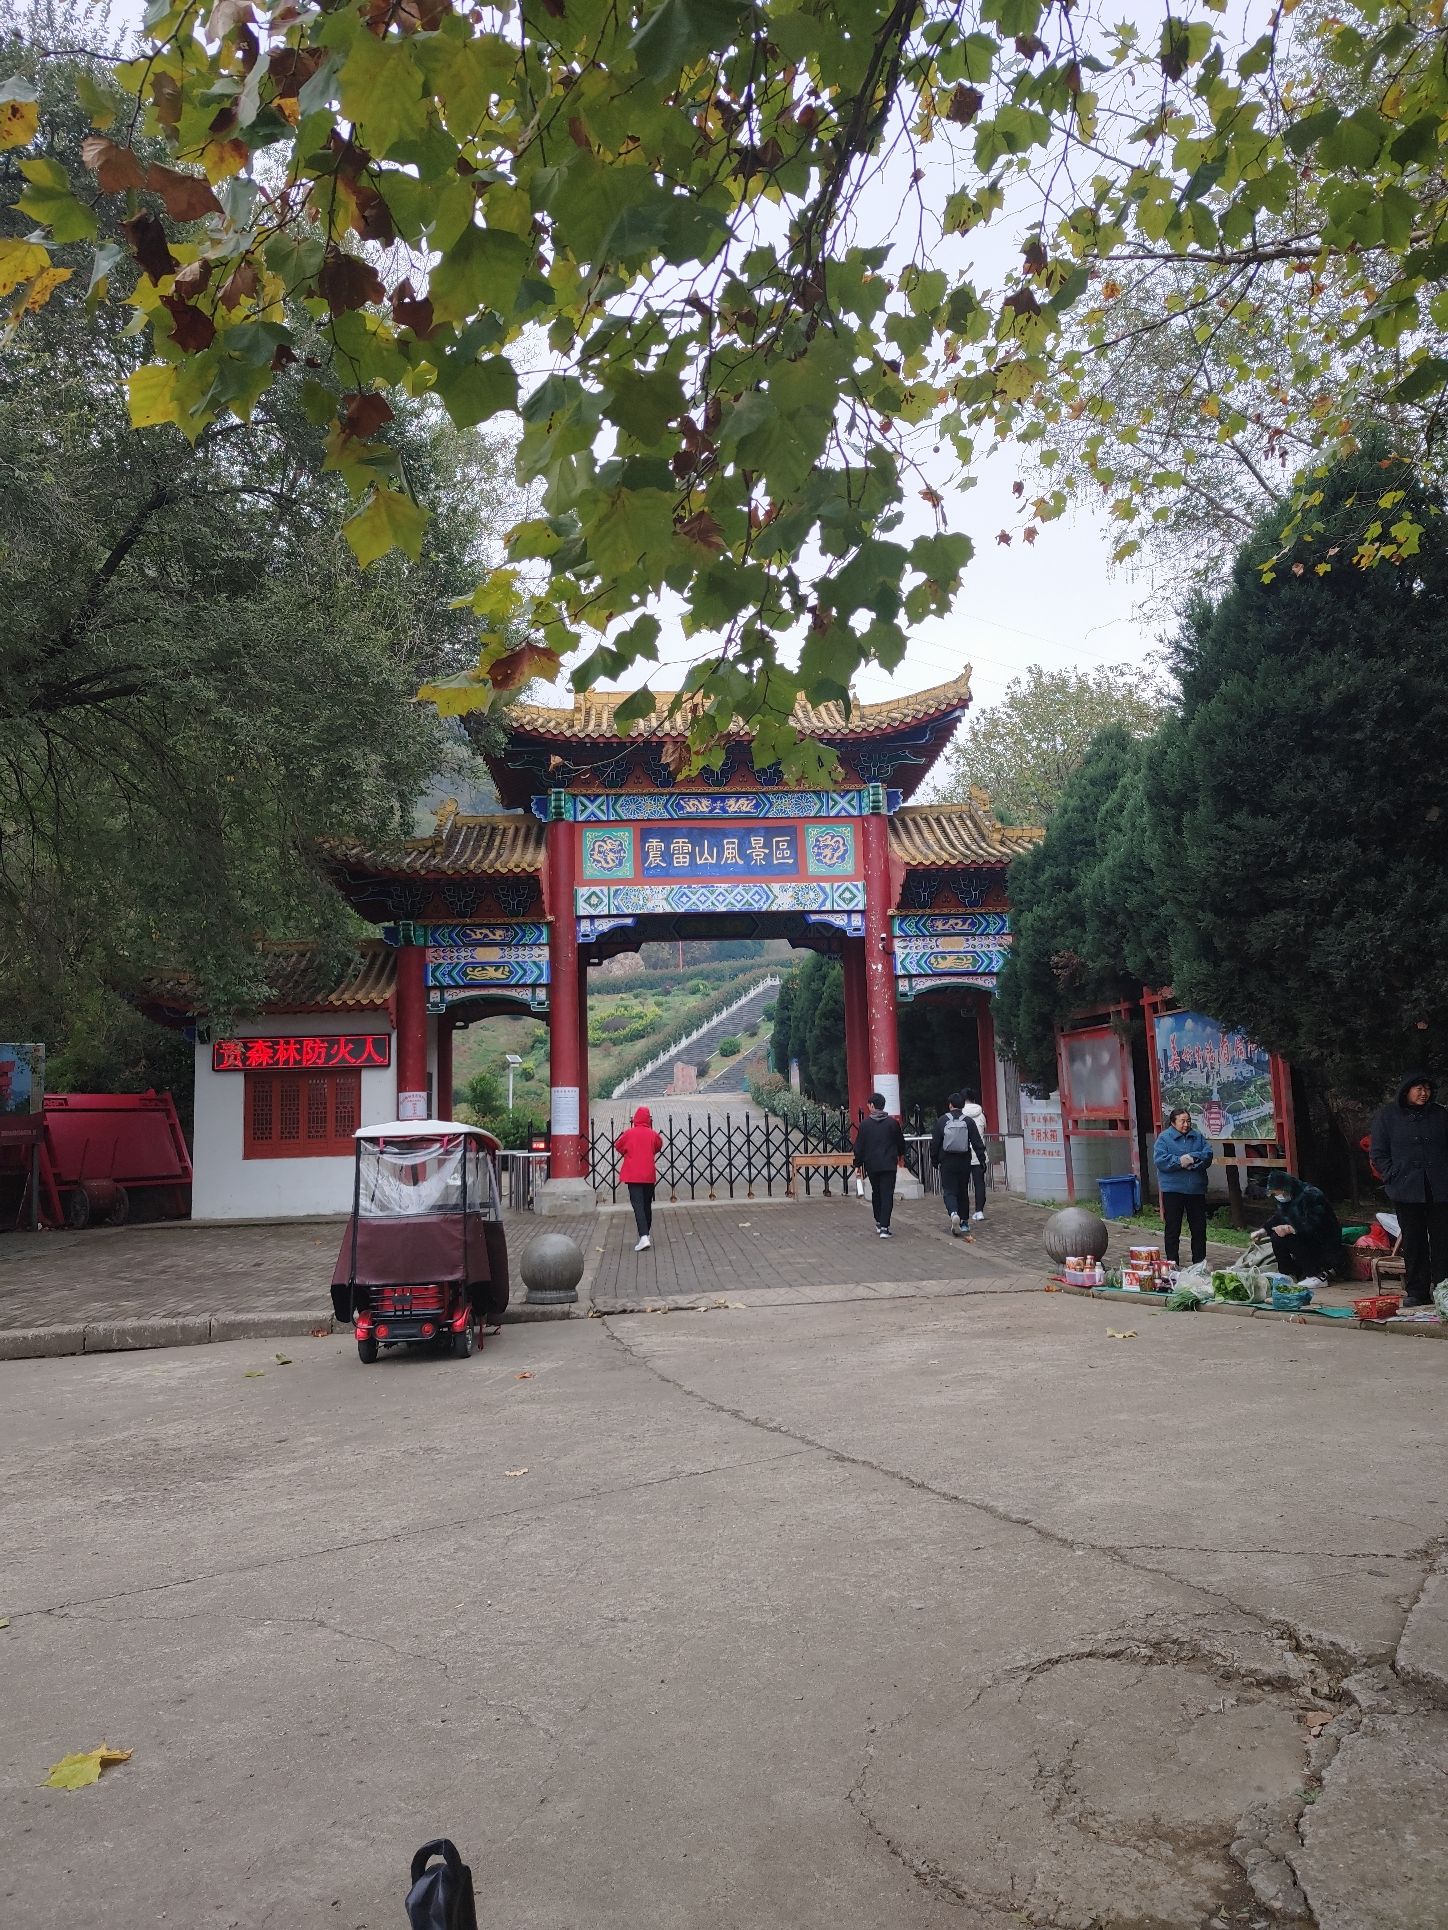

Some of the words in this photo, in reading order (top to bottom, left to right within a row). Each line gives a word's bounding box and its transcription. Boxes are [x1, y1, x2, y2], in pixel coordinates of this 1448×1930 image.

[644, 837, 795, 867] 震雷山風景區
